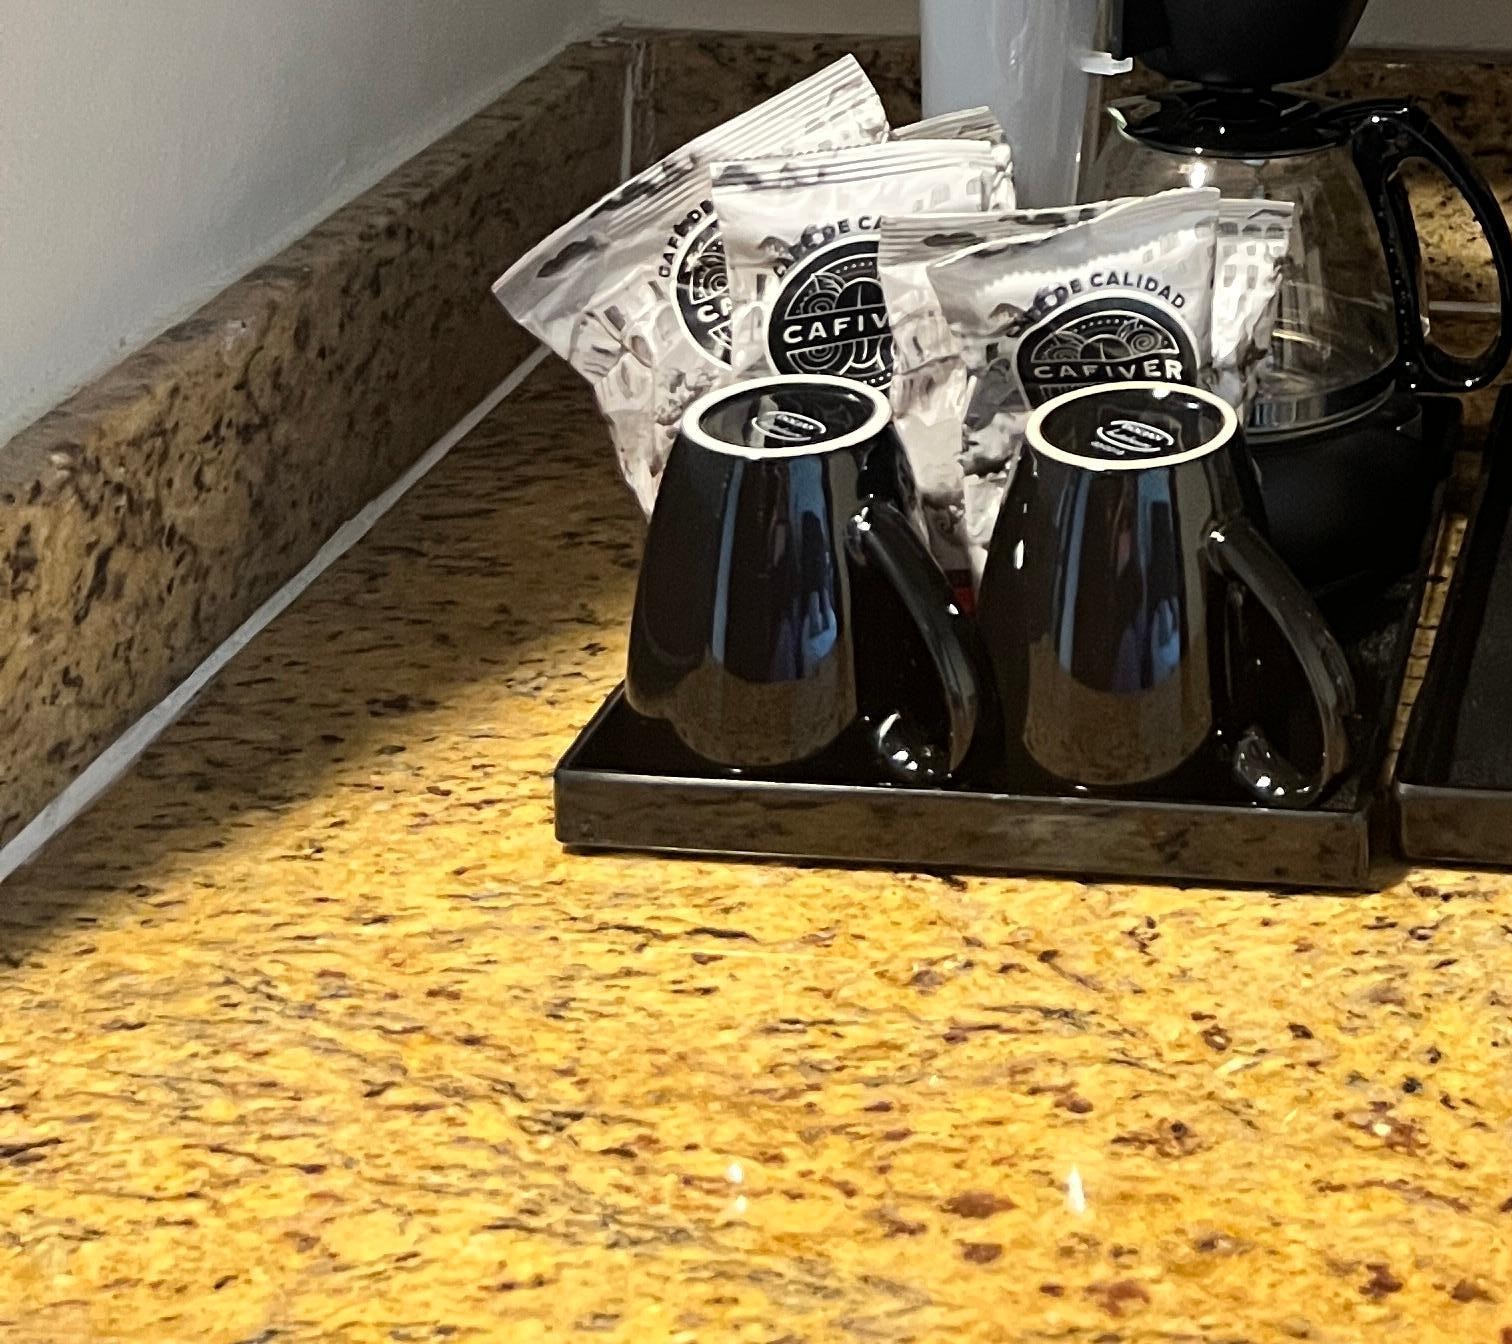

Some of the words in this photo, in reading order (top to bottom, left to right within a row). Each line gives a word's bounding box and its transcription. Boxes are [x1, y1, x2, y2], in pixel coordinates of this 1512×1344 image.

[1090, 270, 1187, 310] CALIDAD
[782, 312, 890, 345] CAFIV
[1033, 358, 1184, 381] CAFIVER
